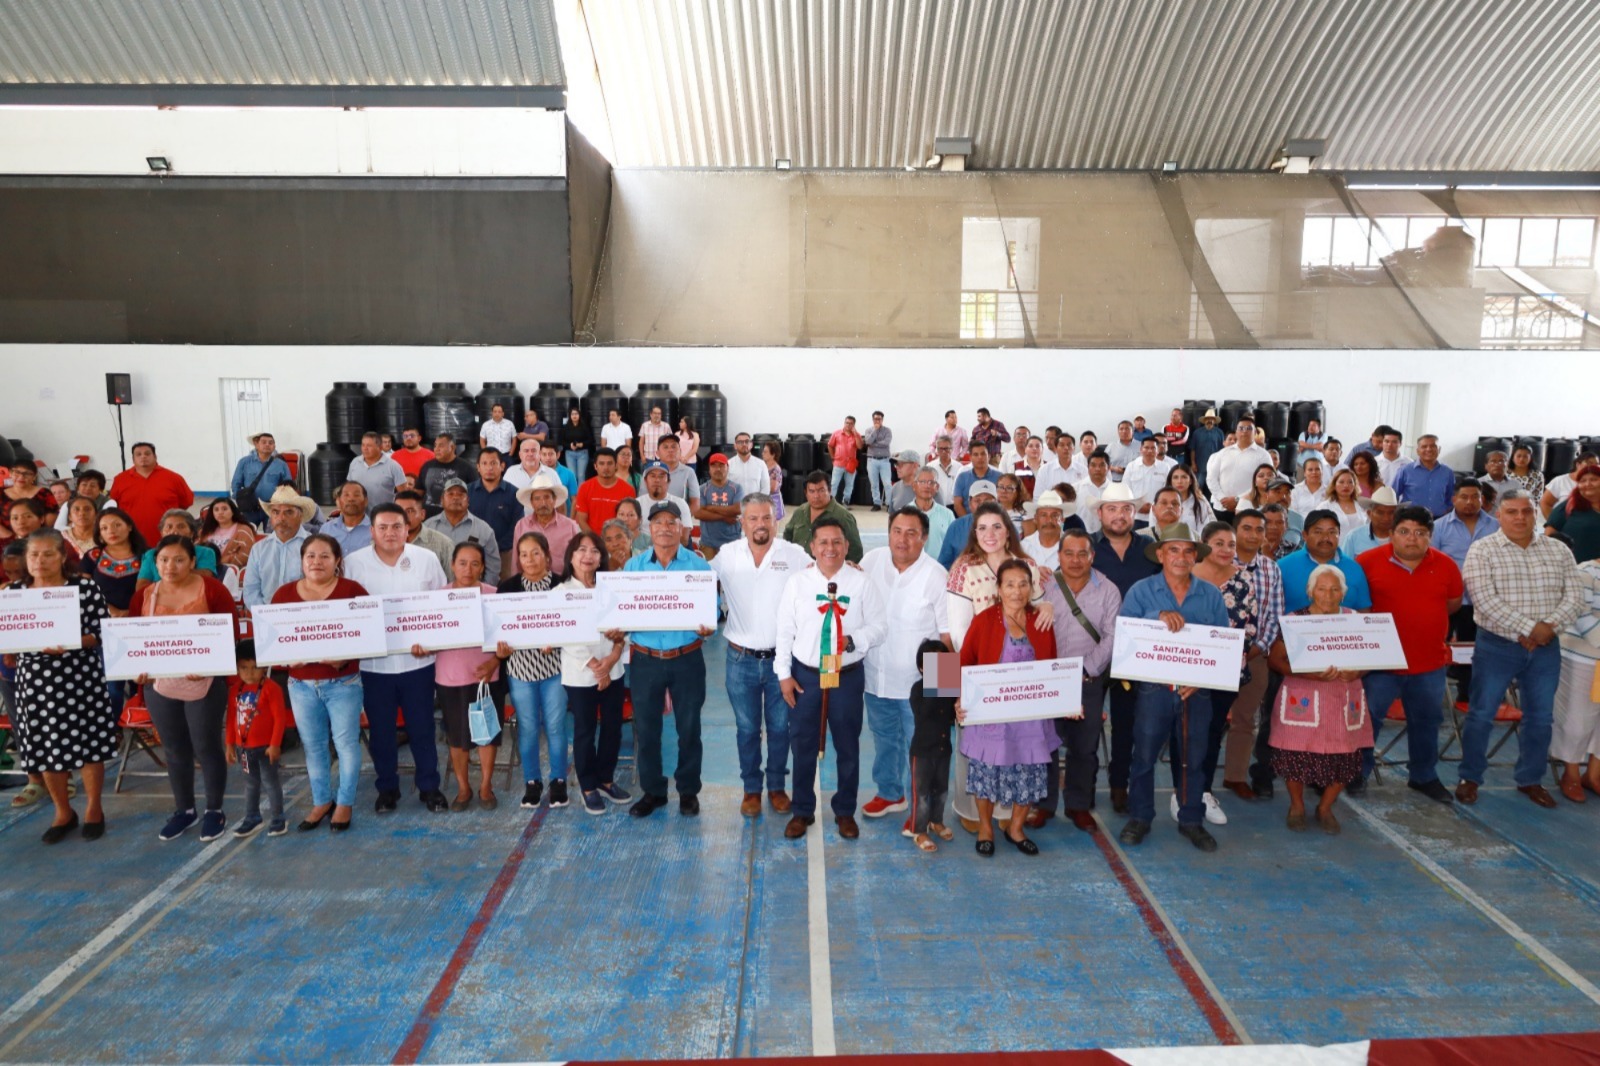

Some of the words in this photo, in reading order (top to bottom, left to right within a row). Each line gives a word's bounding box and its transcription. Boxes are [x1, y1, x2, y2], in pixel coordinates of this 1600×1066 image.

[633, 594, 679, 602] SANITARIO
[638, 602, 695, 610] BIODIGESTOR
[396, 613, 443, 624] SANITARIO
[516, 613, 561, 622] SANITARIO
[0, 621, 54, 631] ODIGESTOR
[294, 623, 344, 633] SANITARIO
[385, 625, 400, 633] ON
[402, 620, 459, 631] BIODIGESTOR
[521, 620, 577, 629] BIODIGESTOR
[278, 635, 298, 643] CON
[300, 630, 361, 641] BIODIGESTOR
[1320, 635, 1363, 643] SANITARIO
[144, 639, 193, 648] SANITARIO
[1307, 644, 1325, 652] CON
[1327, 642, 1380, 651] BIODIGESTOR
[127, 650, 147, 658] CON
[149, 647, 211, 657] BIODIGESTOR
[1153, 644, 1201, 657] SANITARIO
[1135, 652, 1155, 660] CON
[1156, 654, 1217, 666] BIODIGESTOR
[999, 684, 1045, 694] SANITARIO
[1003, 690, 1060, 702] BIODIGESTOR
